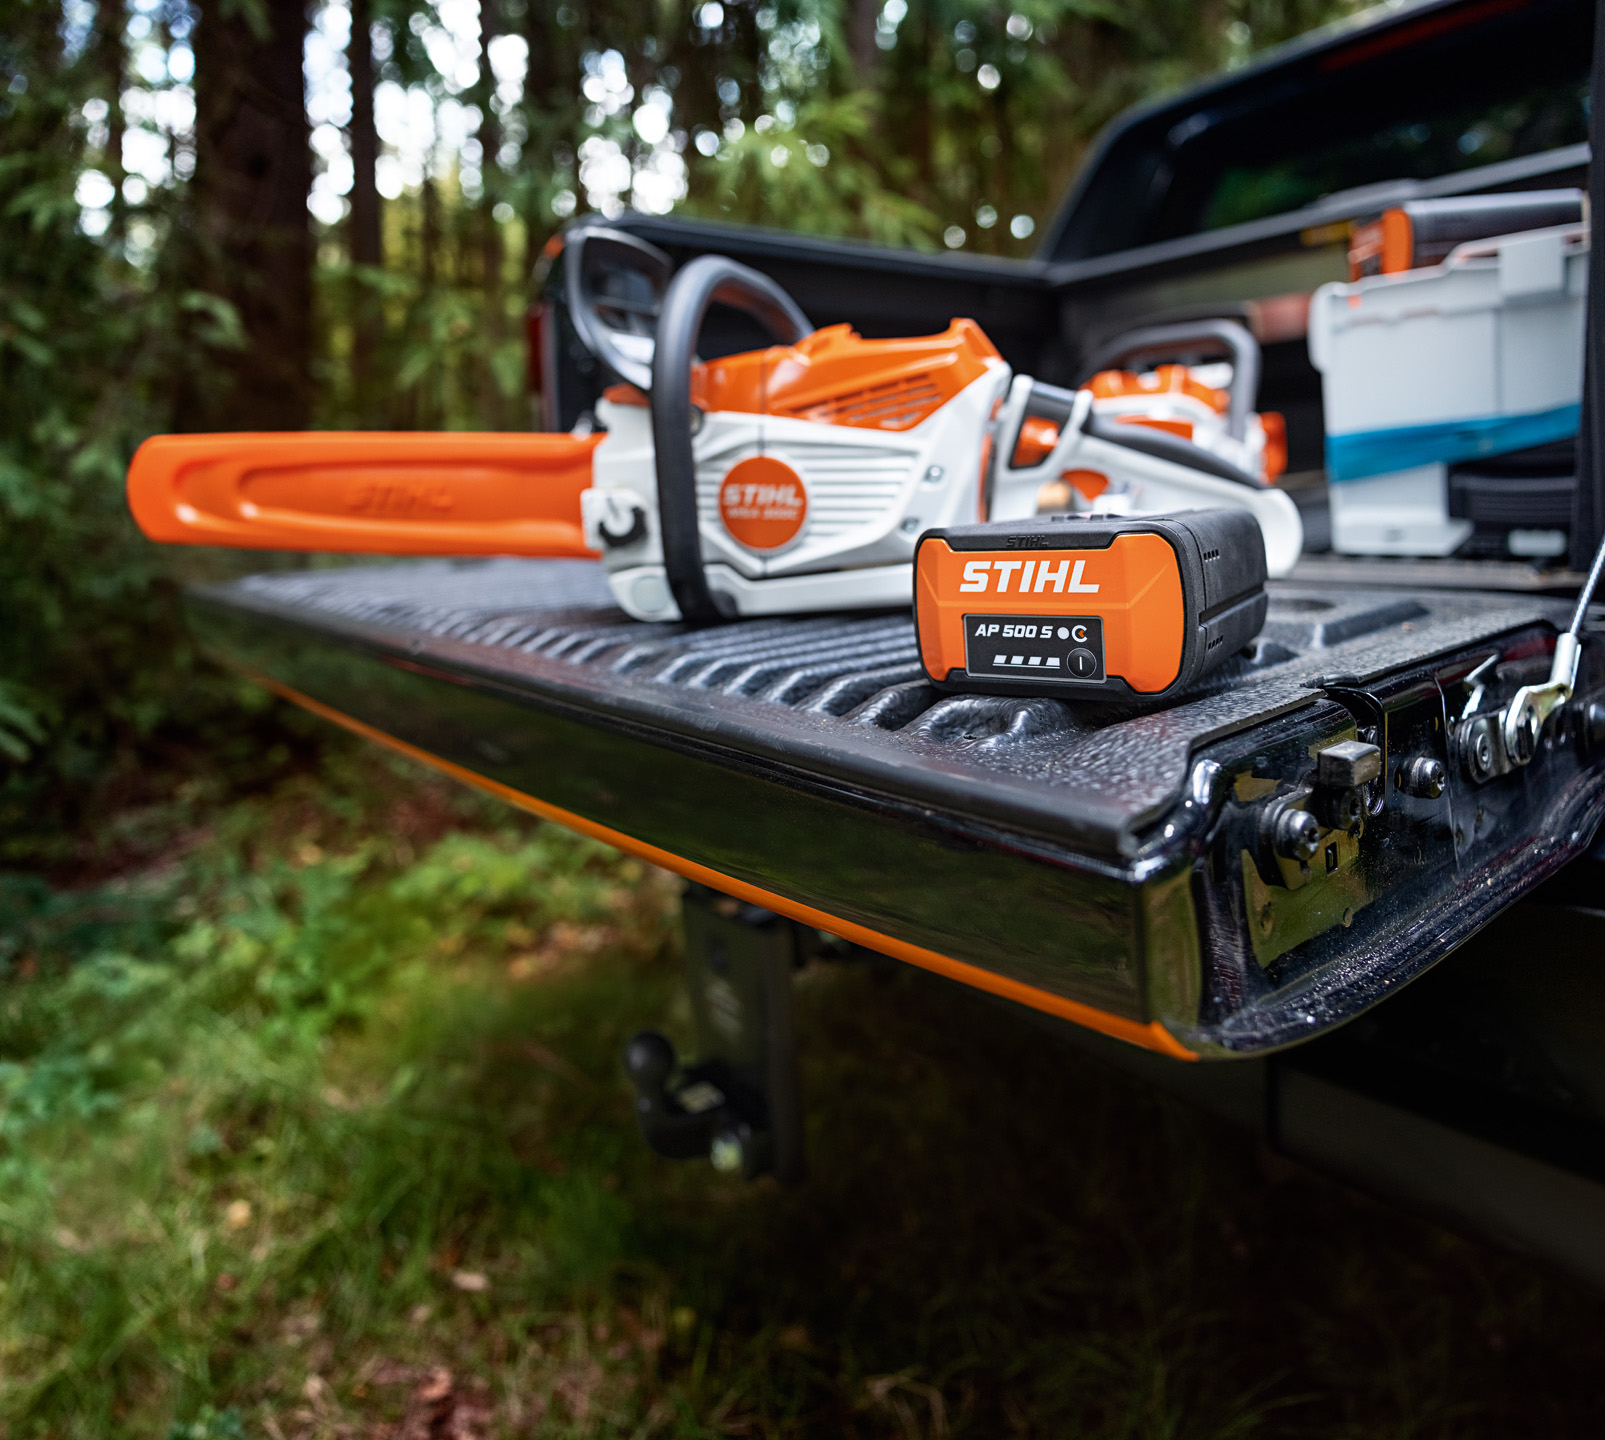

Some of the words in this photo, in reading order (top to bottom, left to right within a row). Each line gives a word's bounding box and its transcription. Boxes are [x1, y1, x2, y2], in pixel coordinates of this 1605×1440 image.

[723, 483, 803, 507] STIHL
[1006, 534, 1050, 548] STIHL
[959, 559, 1100, 593] STIHL
[974, 623, 1000, 637] AP
[1002, 624, 1038, 638] 500
[1039, 625, 1054, 639] S
